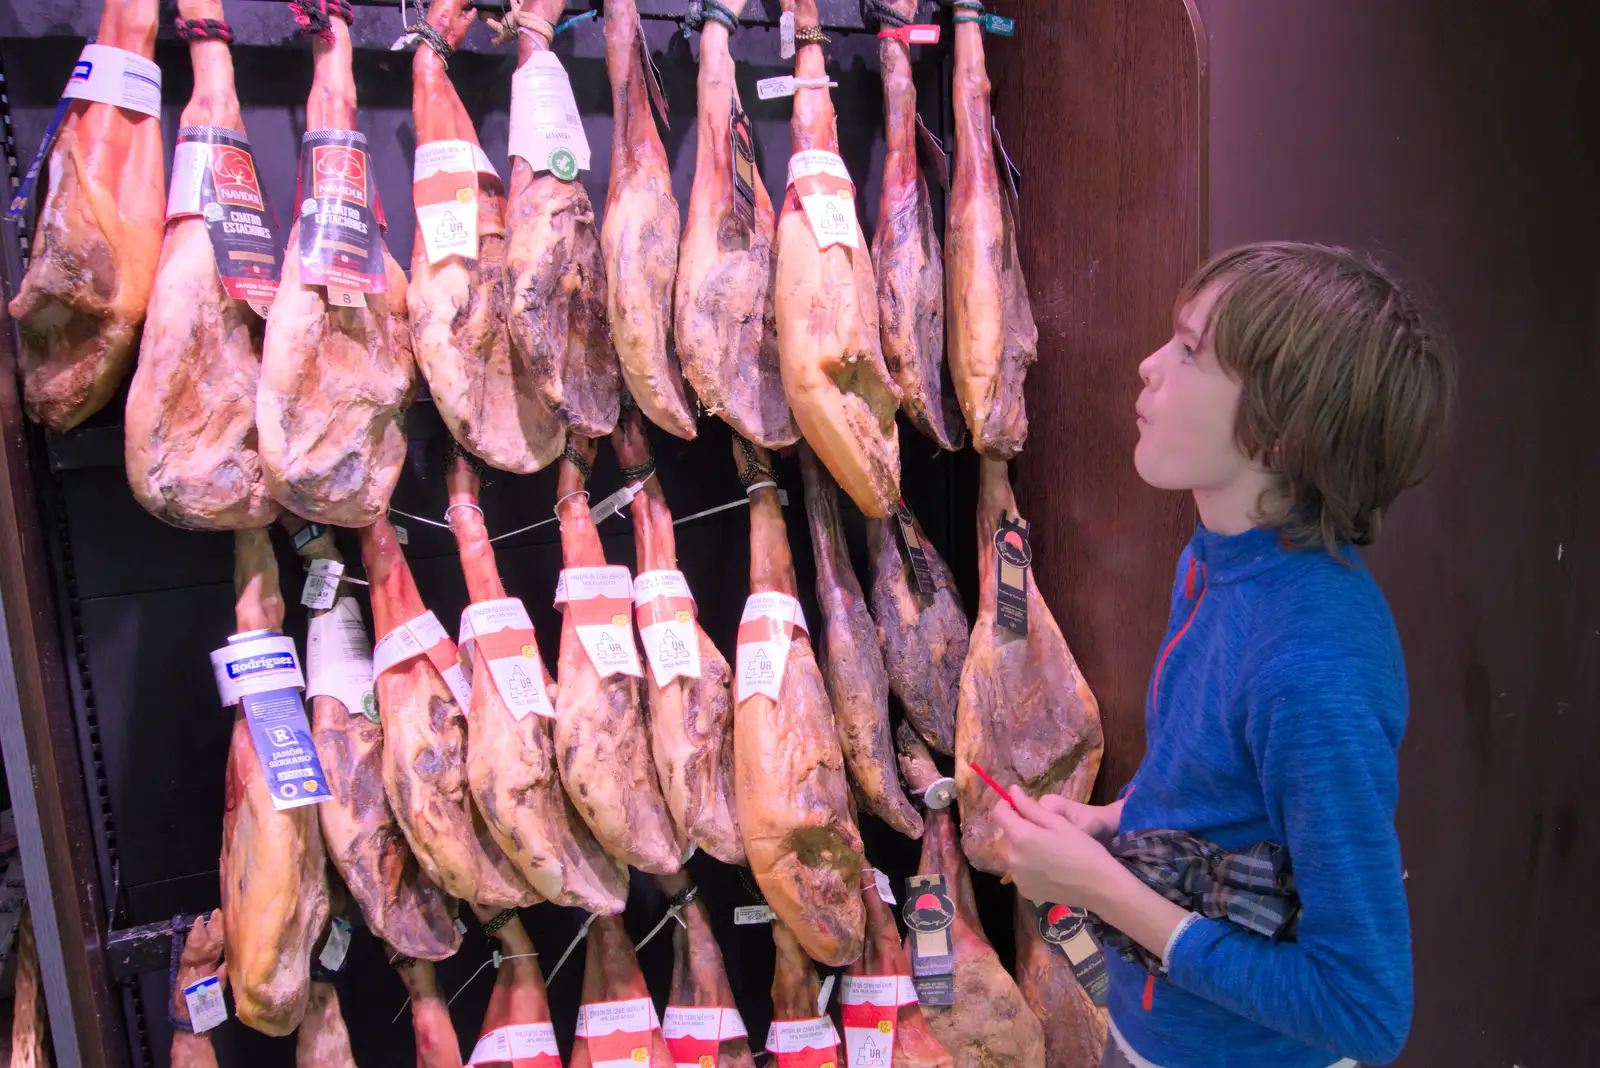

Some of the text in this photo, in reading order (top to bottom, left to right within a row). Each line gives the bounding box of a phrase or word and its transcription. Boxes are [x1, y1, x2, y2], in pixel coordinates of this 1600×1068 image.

[220, 188, 261, 205] NAVIDUL
[318, 184, 365, 202] NAVIDUL
[230, 211, 262, 226] CUATRO
[324, 203, 360, 220] CUATRO
[222, 222, 272, 239] ESTACIONES
[315, 213, 368, 234] ESTACIONES
[343, 293, 352, 304] 8
[230, 655, 294, 674] Rodríguez
[272, 729, 290, 743] R
[268, 755, 312, 768] SERRANO
[271, 747, 304, 761] JAMÓN
